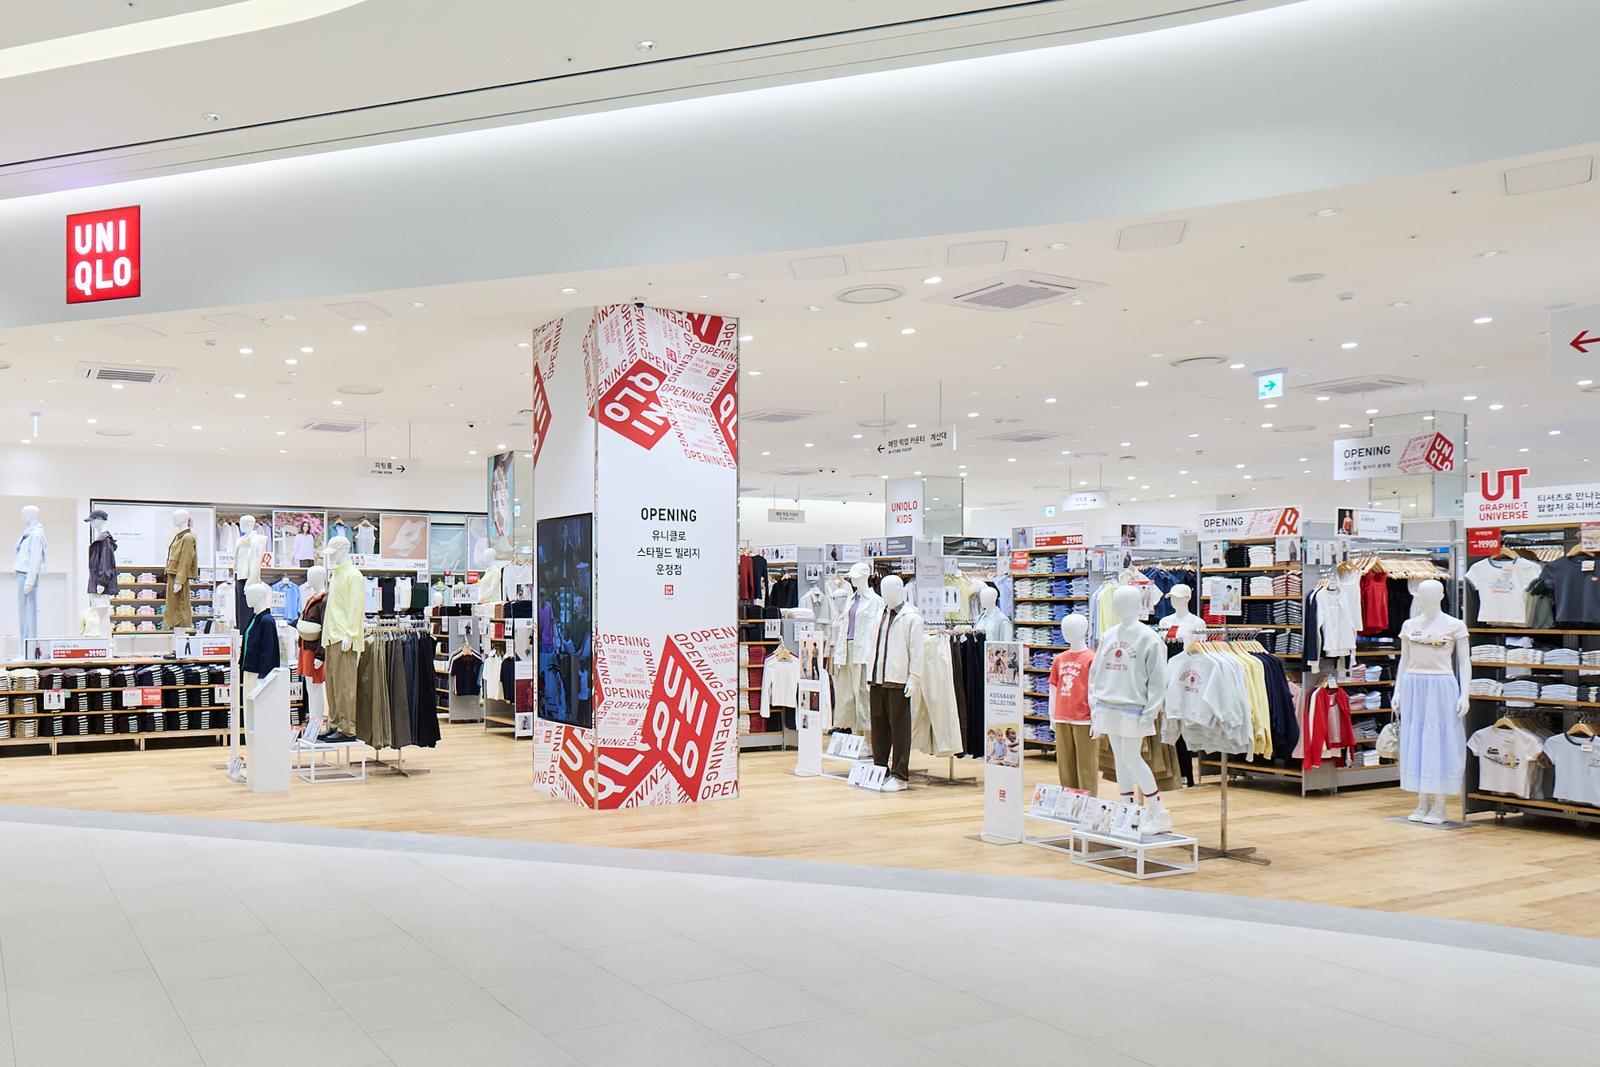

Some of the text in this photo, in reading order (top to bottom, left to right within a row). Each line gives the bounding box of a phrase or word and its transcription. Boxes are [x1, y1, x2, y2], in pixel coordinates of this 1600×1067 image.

[74, 219, 127, 255] UNI
[74, 256, 132, 296] QLO
[668, 341, 702, 383] OPENING
[703, 363, 736, 404] OPENING
[604, 372, 660, 422] QLO
[660, 384, 704, 402] OPENING
[684, 449, 727, 467] OPENING
[1343, 445, 1392, 459] OPENING
[1481, 469, 1528, 501] UT
[641, 507, 697, 522] OPENING
[891, 500, 918, 512] UNIQLO
[1479, 502, 1529, 512] GRAPHIC-T
[896, 514, 913, 524] KIDS
[1203, 516, 1244, 528] OPENING
[1479, 510, 1529, 521] UNIVERSE
[652, 529, 687, 542] 유니클로
[636, 546, 701, 559] 스타필드 빌리지
[655, 564, 683, 576] 운정점
[602, 634, 651, 648] OPENING
[691, 626, 738, 643] OPENI
[674, 633, 723, 689] OPENING
[604, 687, 652, 700] OPENING
[664, 655, 709, 736] UNI
[652, 701, 700, 778] QLO
[705, 706, 736, 782] OPENING
[548, 726, 564, 785] OPENIN
